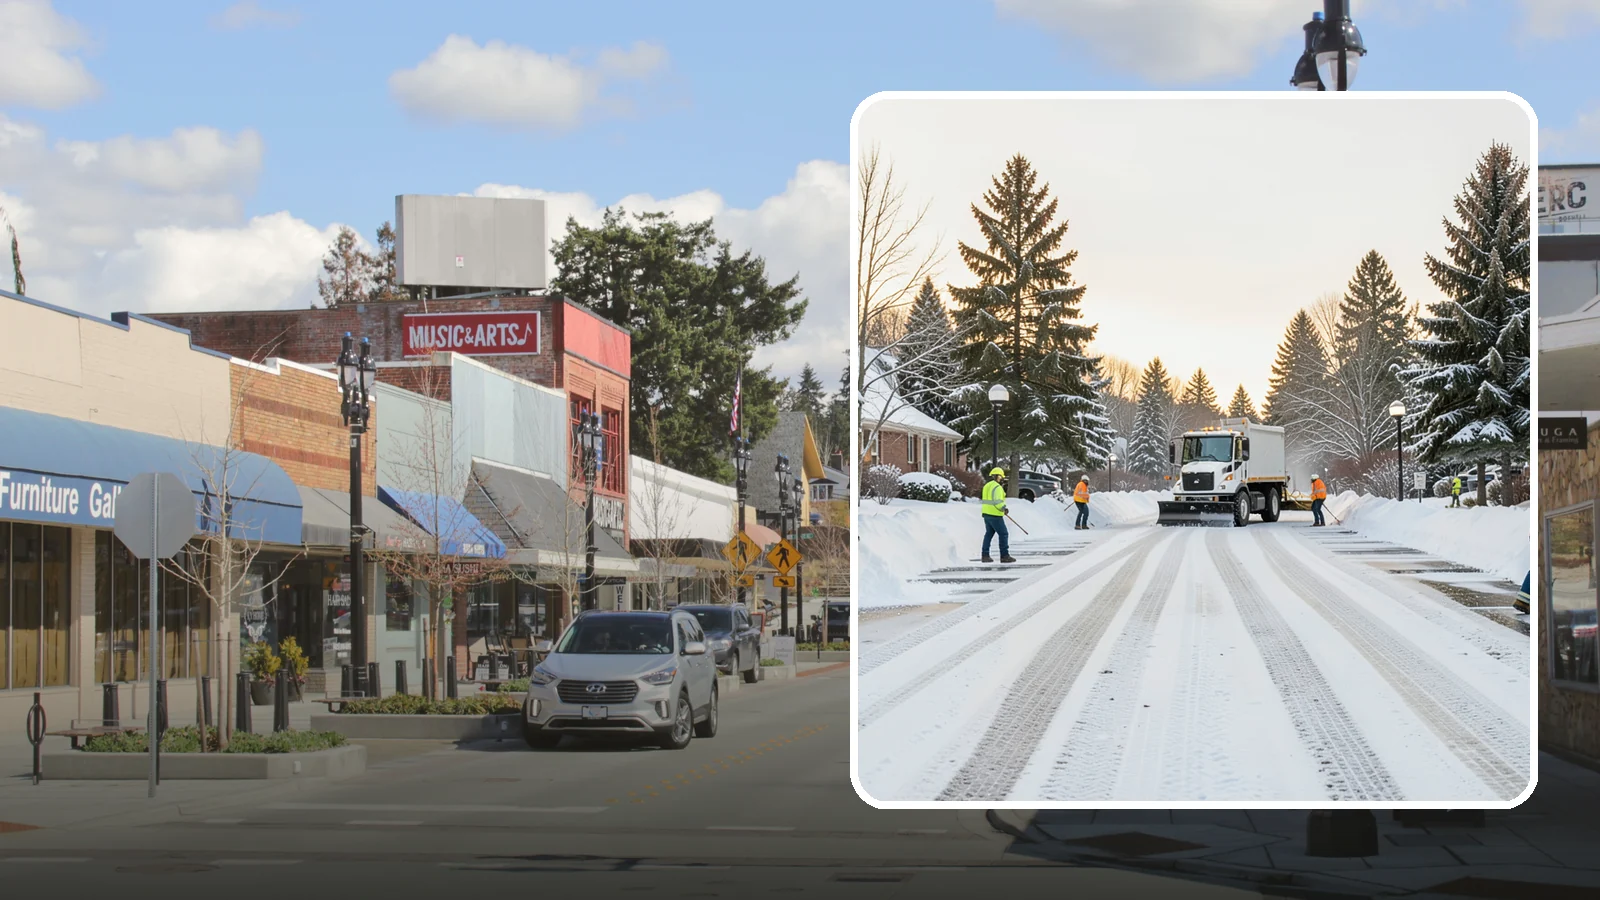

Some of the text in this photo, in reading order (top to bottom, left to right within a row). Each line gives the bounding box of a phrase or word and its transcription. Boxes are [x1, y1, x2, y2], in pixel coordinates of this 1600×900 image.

[409, 323, 519, 348] MUSIC&ARTS
[0, 472, 79, 515] Furniture
[453, 563, 479, 574] SUSHI
